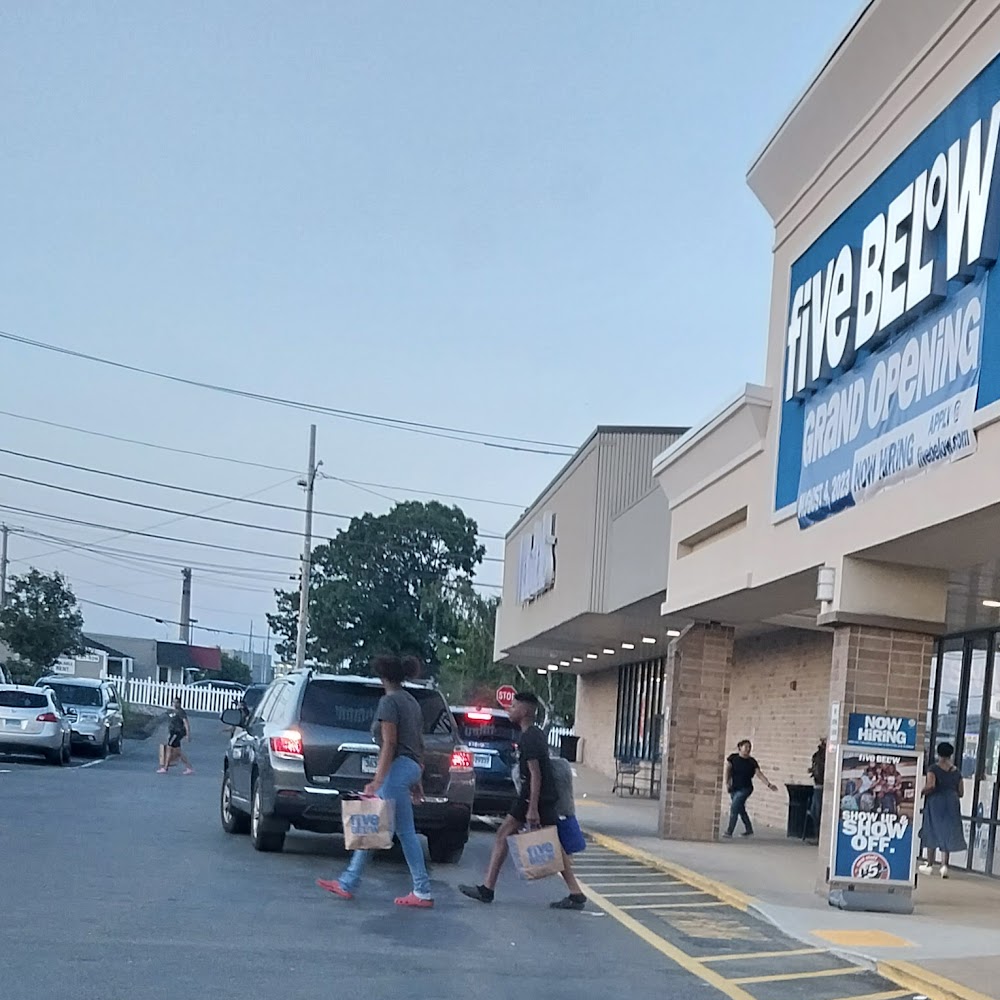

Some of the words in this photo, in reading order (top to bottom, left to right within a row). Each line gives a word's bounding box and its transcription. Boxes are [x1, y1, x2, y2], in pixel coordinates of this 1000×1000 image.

[853, 453, 876, 493] NOW
[831, 468, 851, 502] 2023
[864, 714, 903, 731] NOW
[842, 810, 878, 823] SHOW
[880, 810, 898, 824] UP
[899, 814, 909, 826] &
[842, 821, 908, 840] SHOW
[851, 835, 896, 854] OFF.
